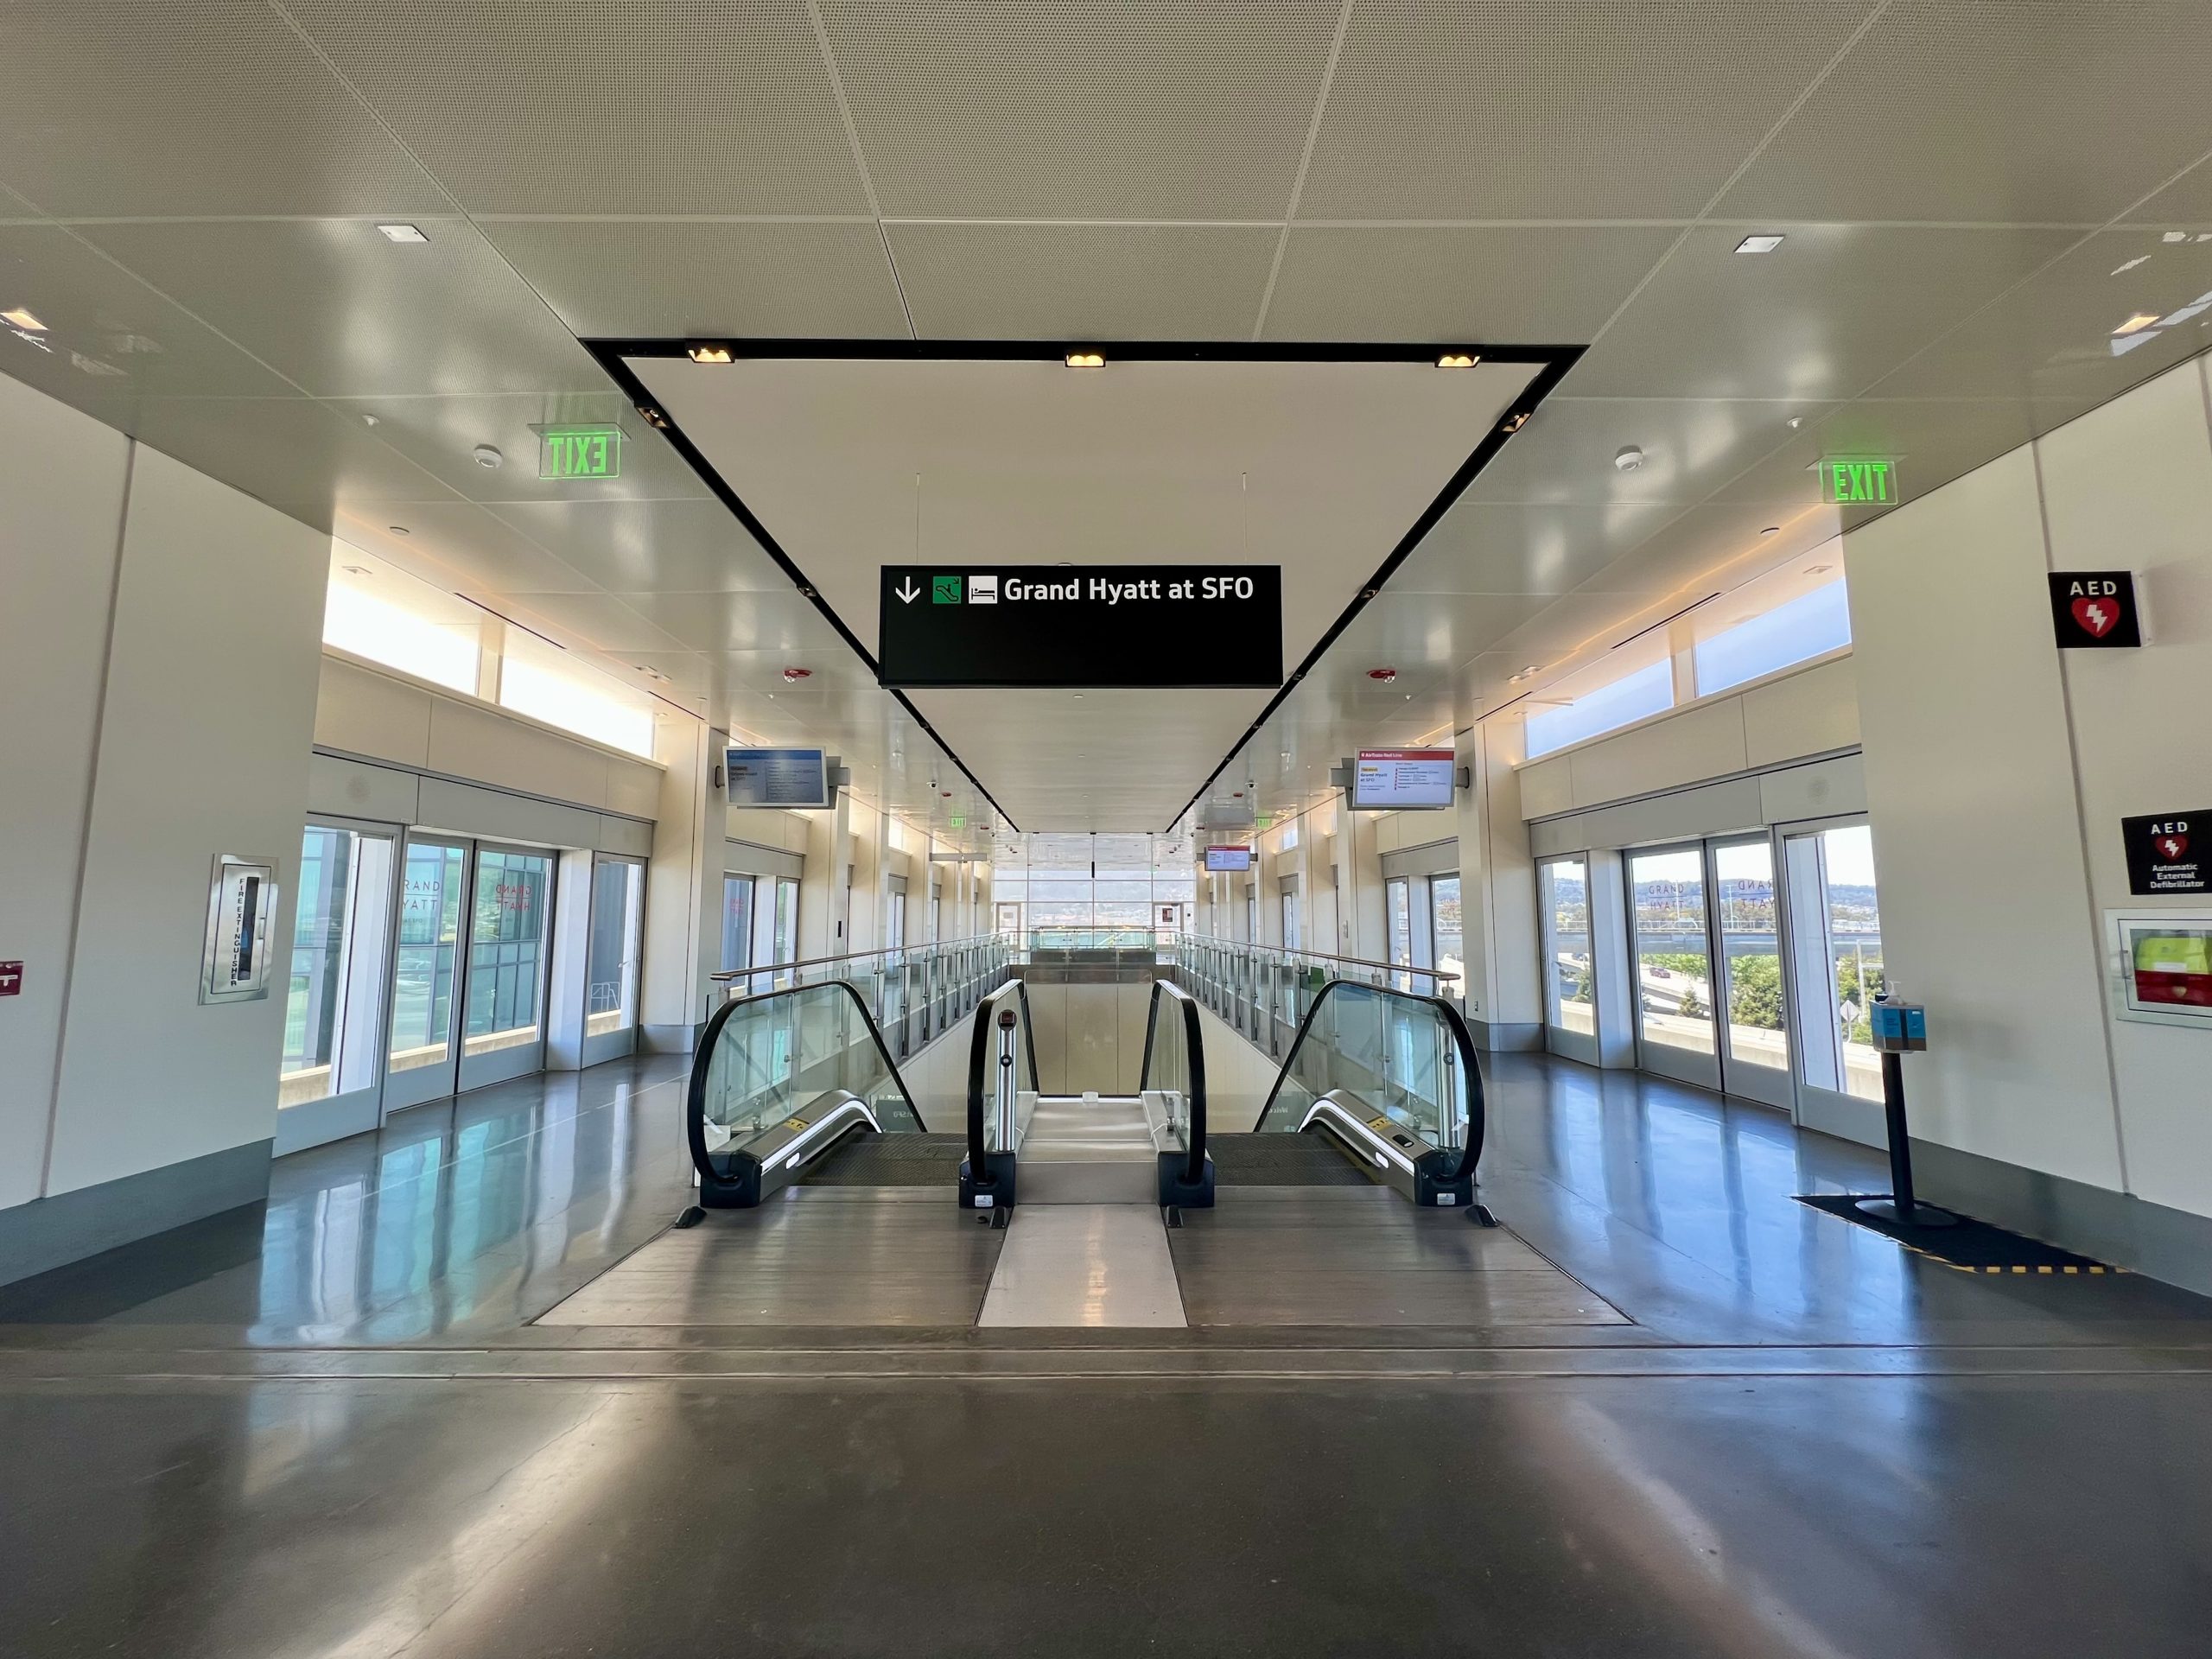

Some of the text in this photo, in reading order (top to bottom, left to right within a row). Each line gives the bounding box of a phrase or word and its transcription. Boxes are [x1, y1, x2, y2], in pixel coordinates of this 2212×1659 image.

[1833, 464, 1887, 500] EXIT
[1005, 577, 1254, 605] Grand Hyatt at SFO
[2069, 581, 2117, 596] AED
[2151, 822, 2188, 835] AED
[237, 878, 245, 905] FIRE
[404, 879, 440, 891] RAND
[1649, 884, 1684, 894] GRAND
[404, 899, 438, 910] YATT
[1650, 900, 1684, 910] HYATT
[231, 906, 243, 987] EXTINGUISHER
